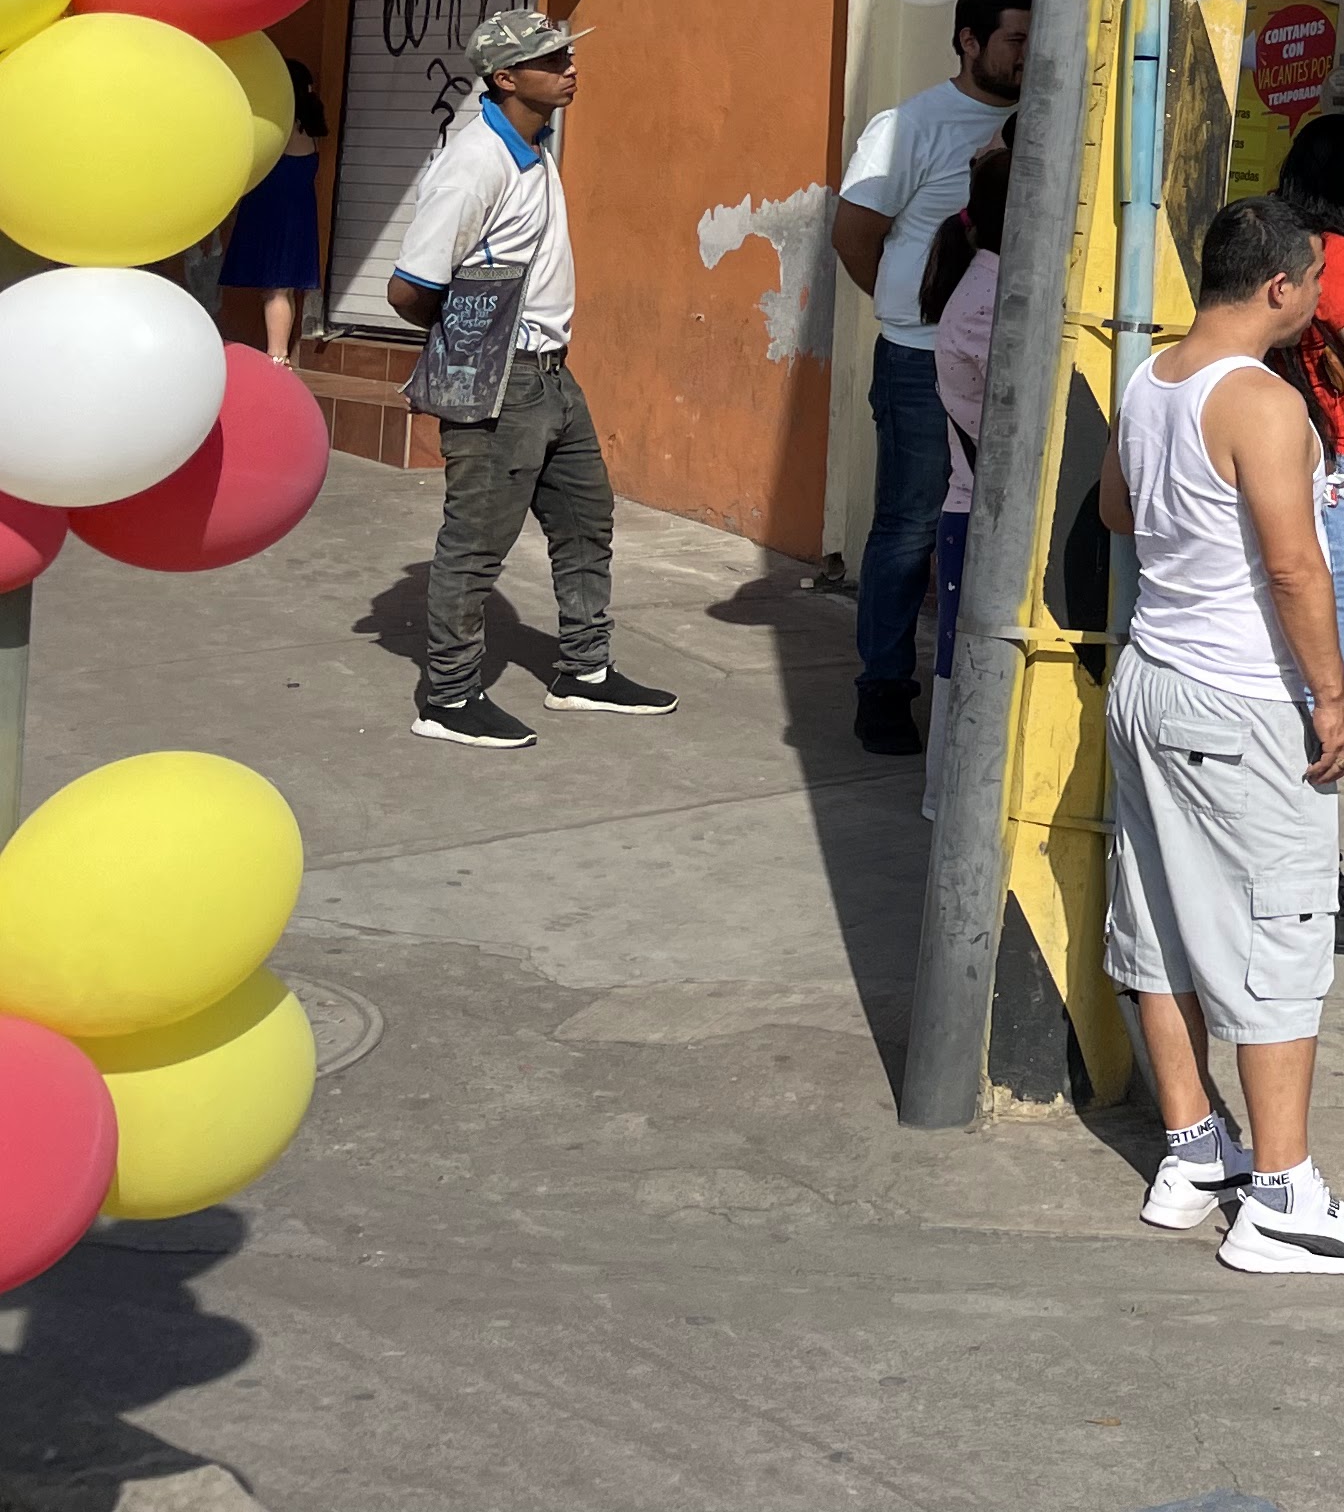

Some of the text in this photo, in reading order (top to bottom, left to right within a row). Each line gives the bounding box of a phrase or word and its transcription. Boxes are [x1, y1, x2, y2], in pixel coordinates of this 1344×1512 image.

[1264, 19, 1326, 45] CONTAMOS
[1282, 40, 1305, 59] CON
[1258, 59, 1310, 90] VACANTES
[443, 289, 499, 312] Jesús
